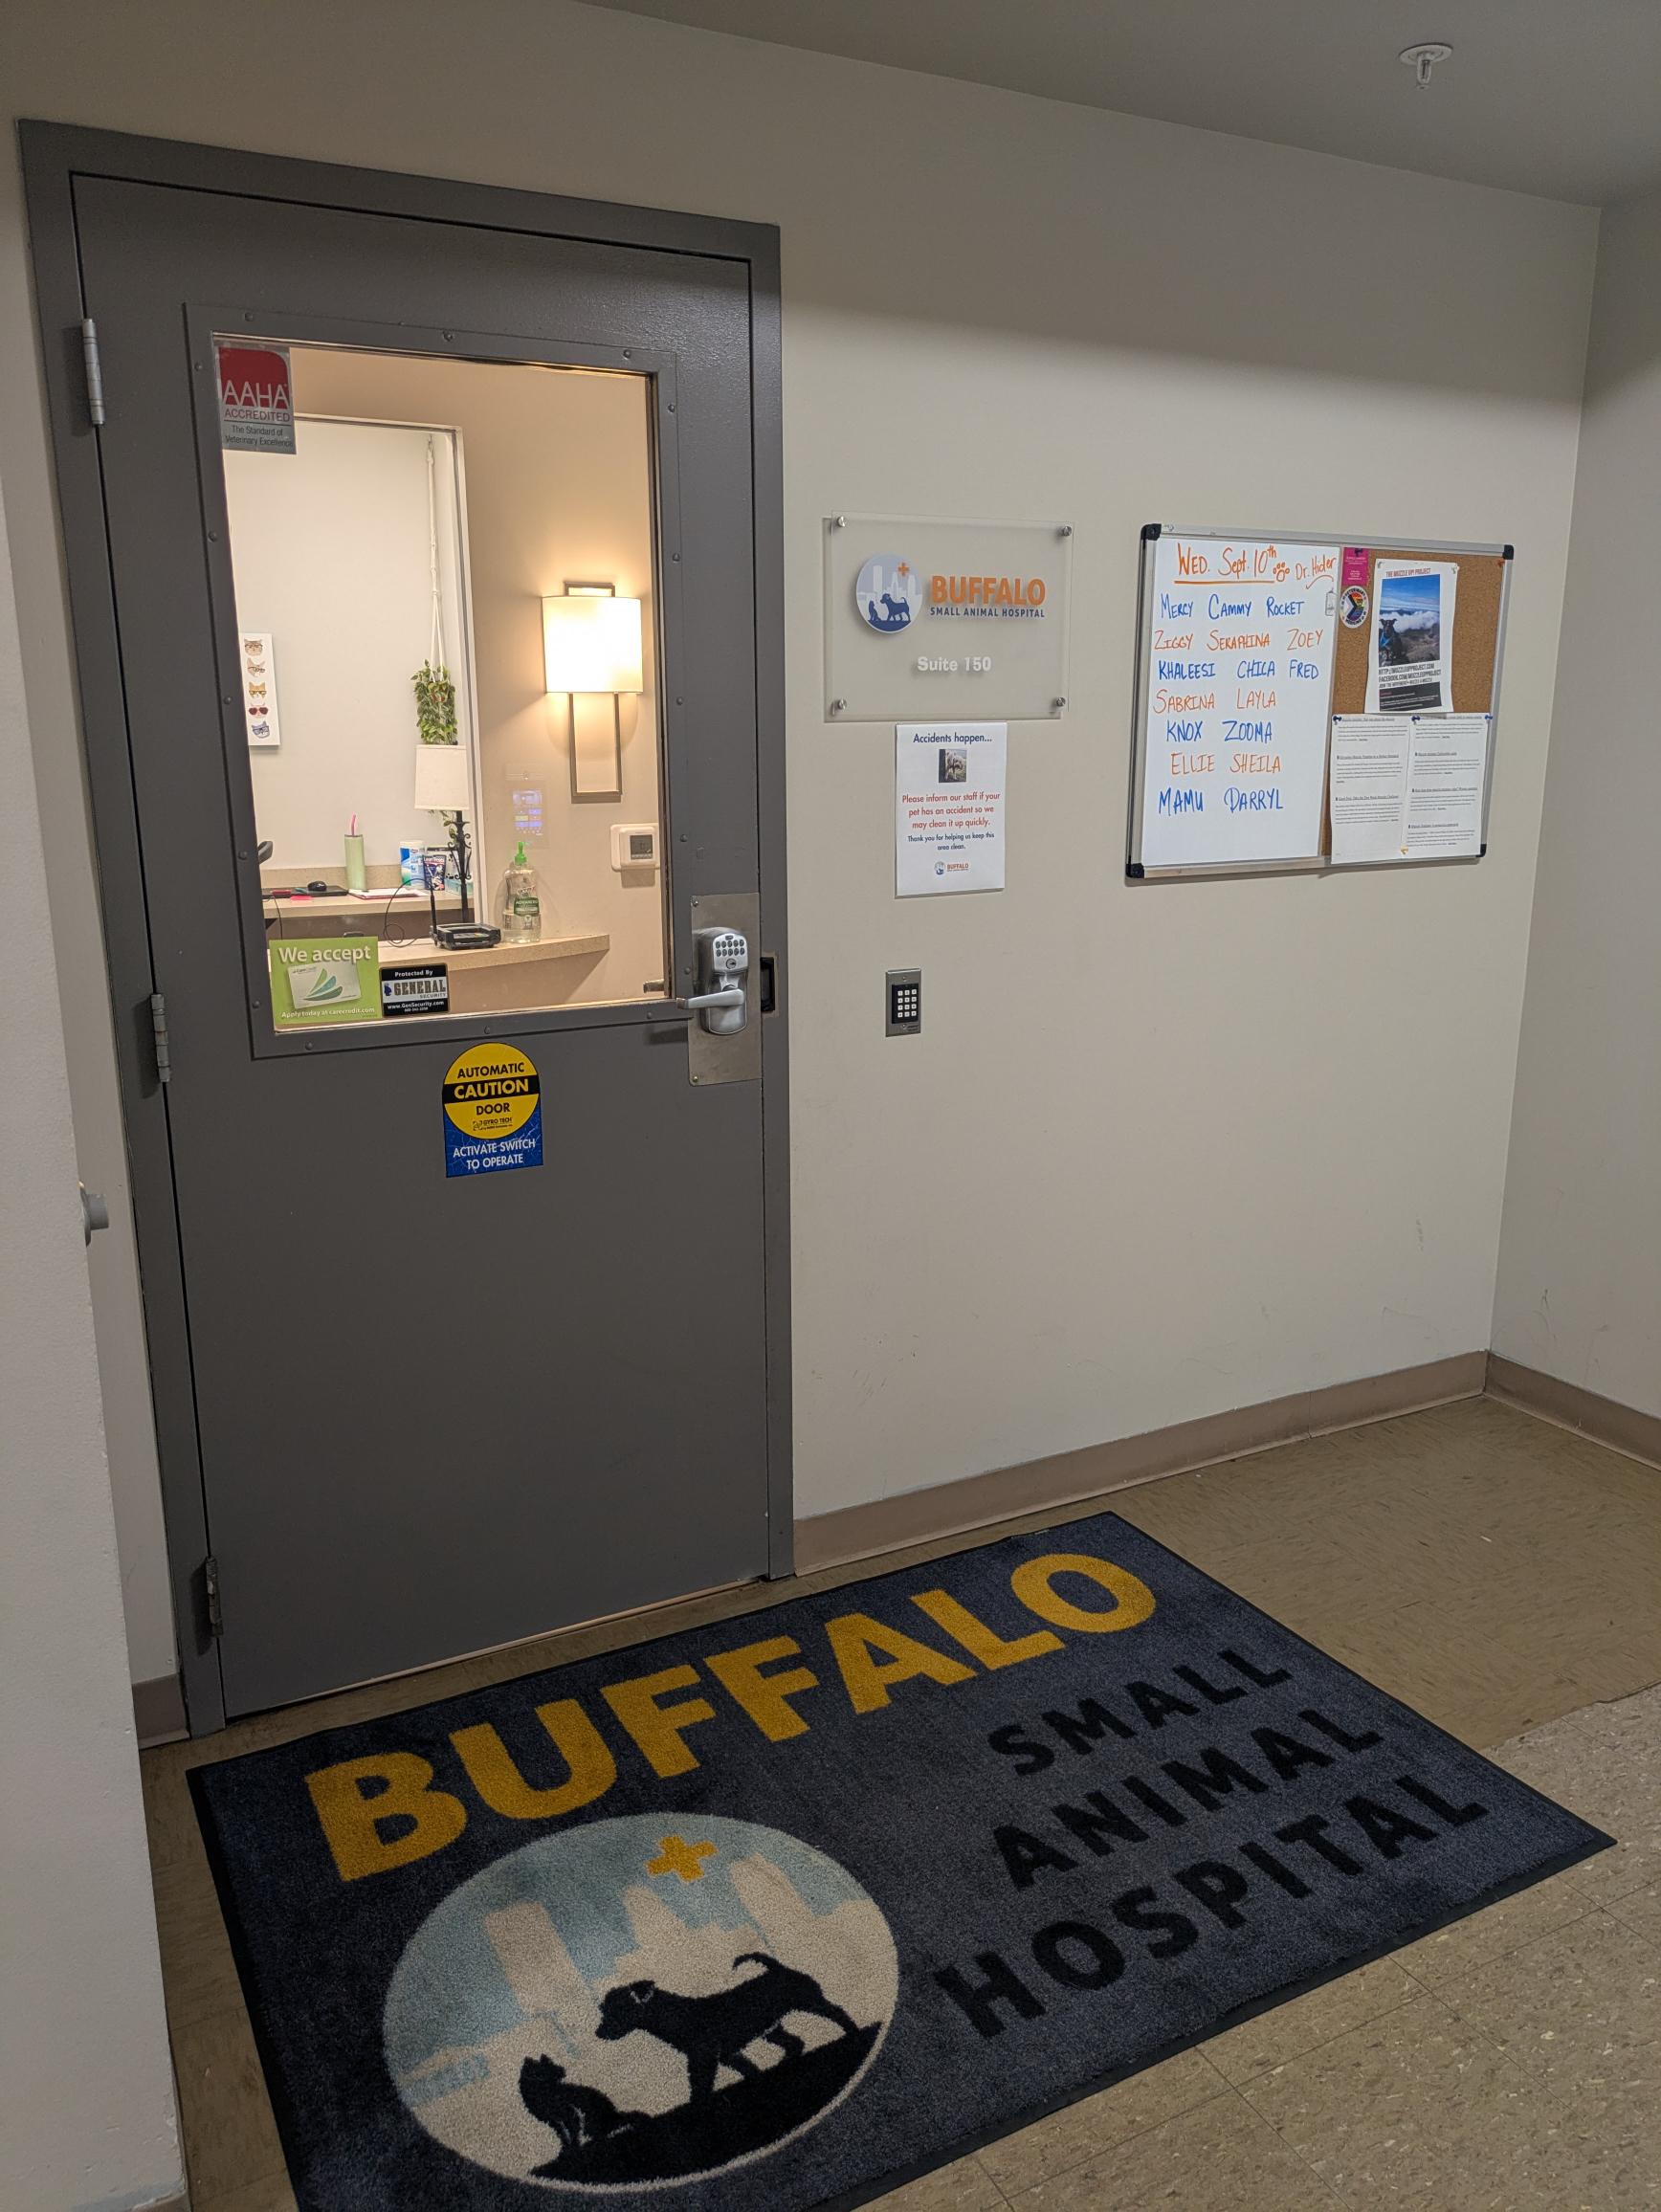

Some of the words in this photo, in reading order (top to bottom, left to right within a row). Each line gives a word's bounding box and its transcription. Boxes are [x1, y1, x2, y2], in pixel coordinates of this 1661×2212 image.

[222, 379, 290, 409] AAHA
[225, 409, 290, 421] ACCREDITED
[232, 425, 244, 433] The
[246, 426, 276, 436] Standard
[276, 428, 283, 436] of
[225, 435, 258, 447] Veterinary
[259, 437, 294, 448] Excellence
[1296, 563, 1310, 580] Dr.
[932, 575, 1046, 606] BUFFALO
[930, 607, 961, 616] SMALL
[963, 608, 999, 617] ANIMAL
[1002, 608, 1045, 618] HOSPITAL
[1161, 593, 1194, 619] MERCY
[1208, 593, 1252, 620] CAMMY
[1266, 596, 1305, 618] ROCKET
[1154, 630, 1194, 651] ZIGGY
[1207, 630, 1271, 651] SERAPHINA
[1287, 629, 1323, 651] ZOEY
[917, 655, 958, 672] Suite
[963, 655, 991, 672] 150
[1159, 660, 1216, 680] KHALEESI
[1237, 659, 1275, 679] CHICA
[1289, 659, 1319, 679] FRED
[1153, 689, 1215, 714] SABRINA
[1237, 688, 1276, 710] LAYLA
[913, 732, 951, 743] Accidents
[954, 731, 992, 744] happen...
[1166, 719, 1204, 742] KNOX
[1222, 720, 1272, 743] ZOOMA
[1171, 753, 1215, 775] ELLIE
[1229, 753, 1281, 774] SHEILA
[902, 793, 924, 804] Please
[926, 792, 948, 803] inform
[963, 791, 978, 801] staff
[979, 791, 985, 800] if
[985, 792, 1001, 802] your
[1159, 787, 1204, 816] MAMU
[1224, 786, 1283, 813] DARRYL
[908, 808, 919, 818] pet
[921, 806, 934, 815] has
[946, 805, 973, 814] accident
[912, 821, 927, 830] may
[929, 819, 947, 829] clean
[955, 820, 963, 829] up
[964, 816, 991, 830] quickly.
[907, 834, 924, 843] Thank
[944, 832, 964, 842] helping
[278, 946, 307, 963] We
[312, 945, 371, 964] accept
[394, 979, 447, 996] GENERAL
[301, 1009, 321, 1018] today
[388, 1001, 444, 1010] www.GenSecurity.com
[457, 1062, 524, 1079] AUTOMATIC
[454, 1078, 529, 1099] CAUTION
[476, 1102, 511, 1116] DOOR
[453, 1142, 498, 1158] ACTIVATE
[499, 1139, 536, 1152] SWITCH
[467, 1160, 479, 1170] TO
[482, 1153, 524, 1168] OPERATE
[303, 1552, 1157, 1882] BUFFALO
[986, 1649, 1294, 1777] SMALL
[992, 1708, 1384, 1891] ANIMAL
[933, 1774, 1489, 2038] HOSPITAL
